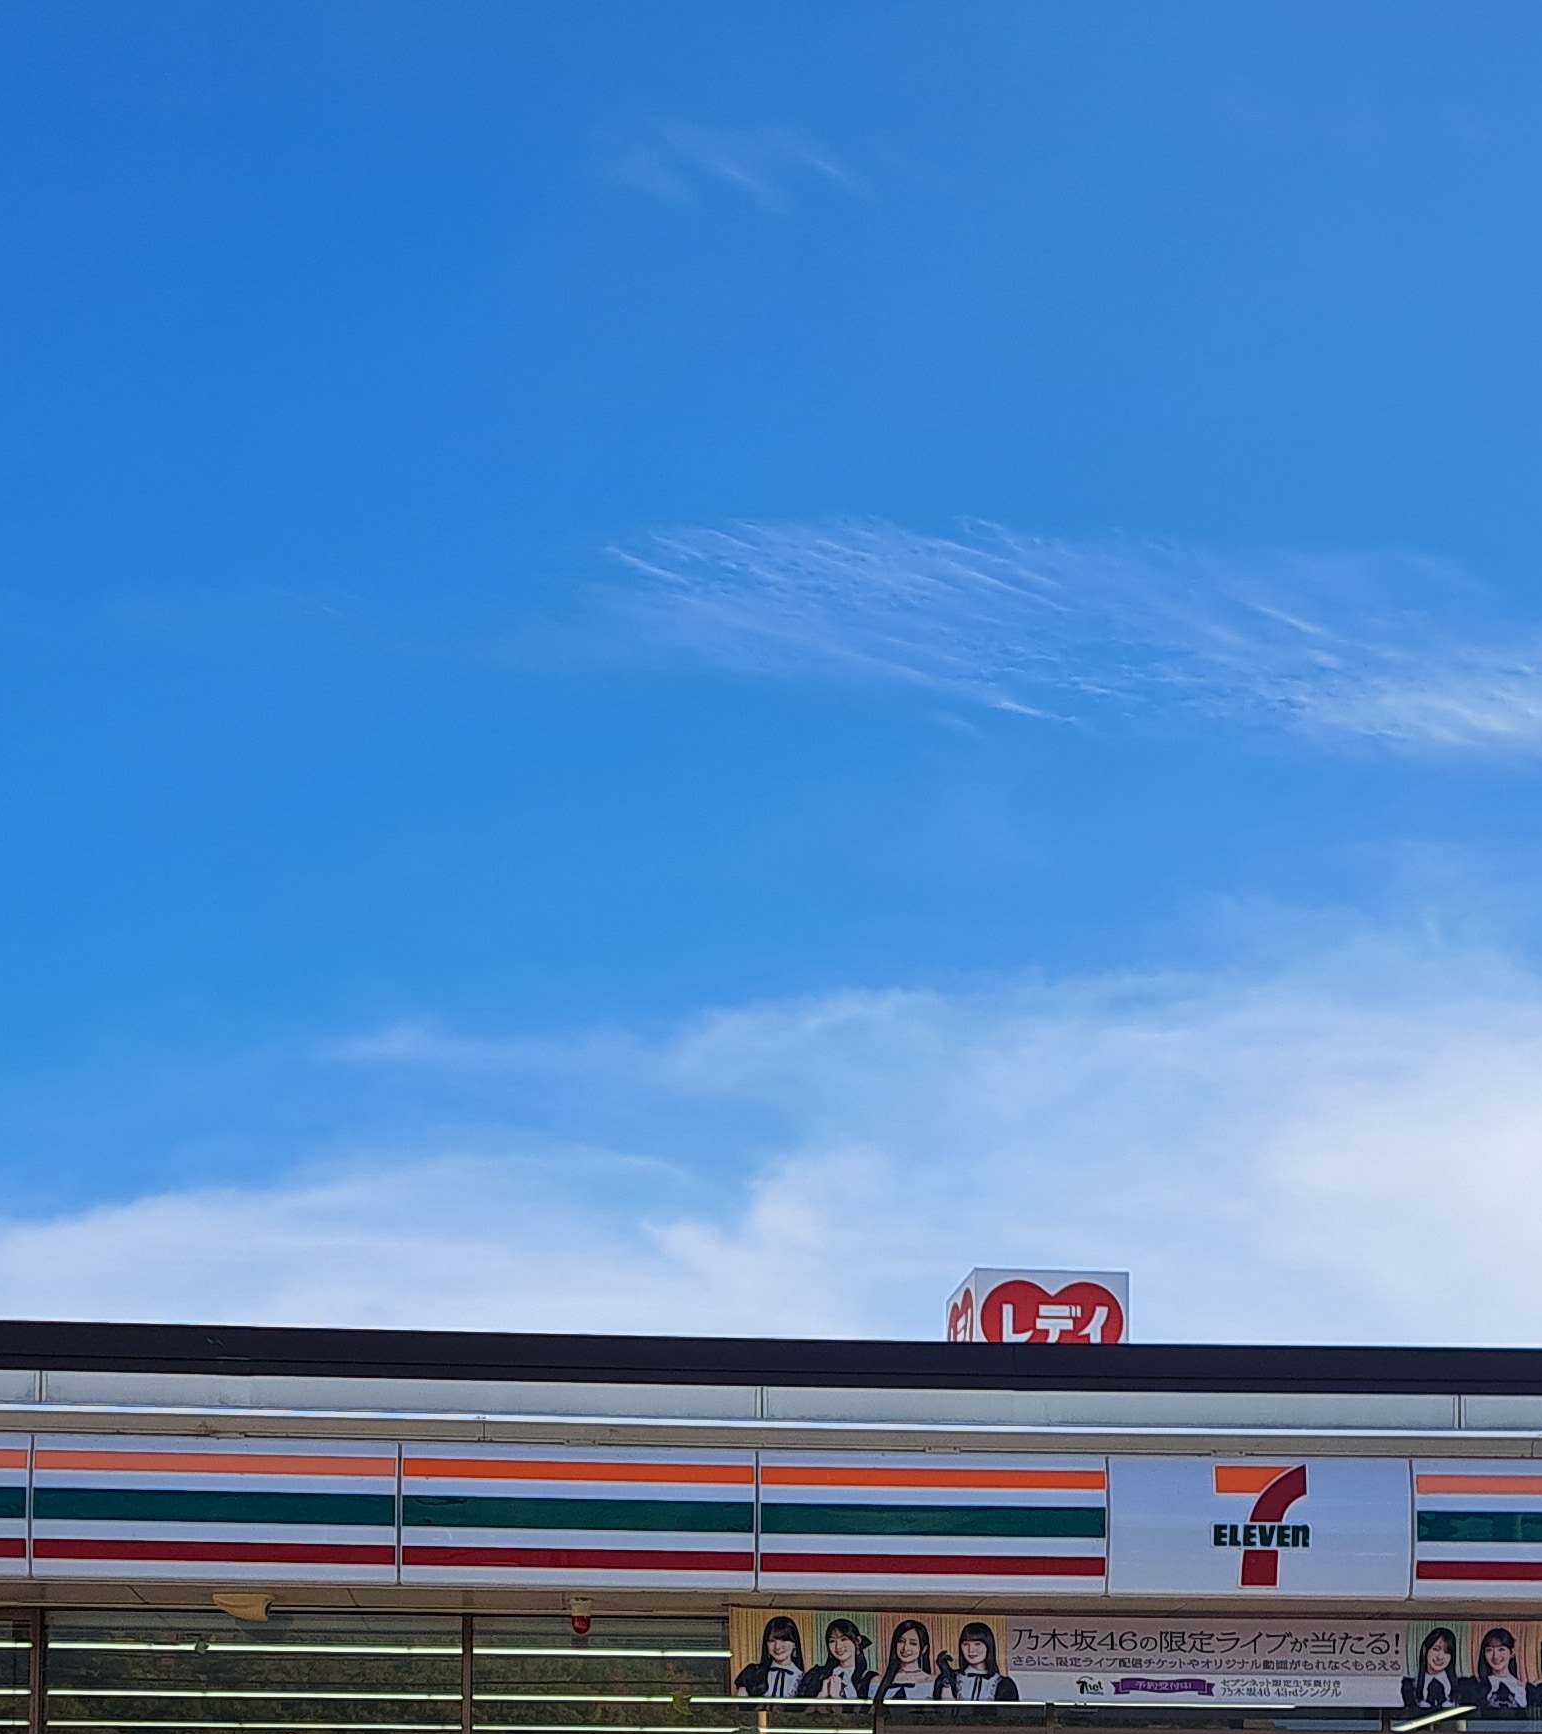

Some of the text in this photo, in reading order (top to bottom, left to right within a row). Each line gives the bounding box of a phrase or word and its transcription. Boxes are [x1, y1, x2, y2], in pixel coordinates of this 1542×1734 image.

[1001, 1303, 1109, 1344] レディ
[1011, 1627, 1401, 1656] 乃木坂46の限定ライブが当たる!
